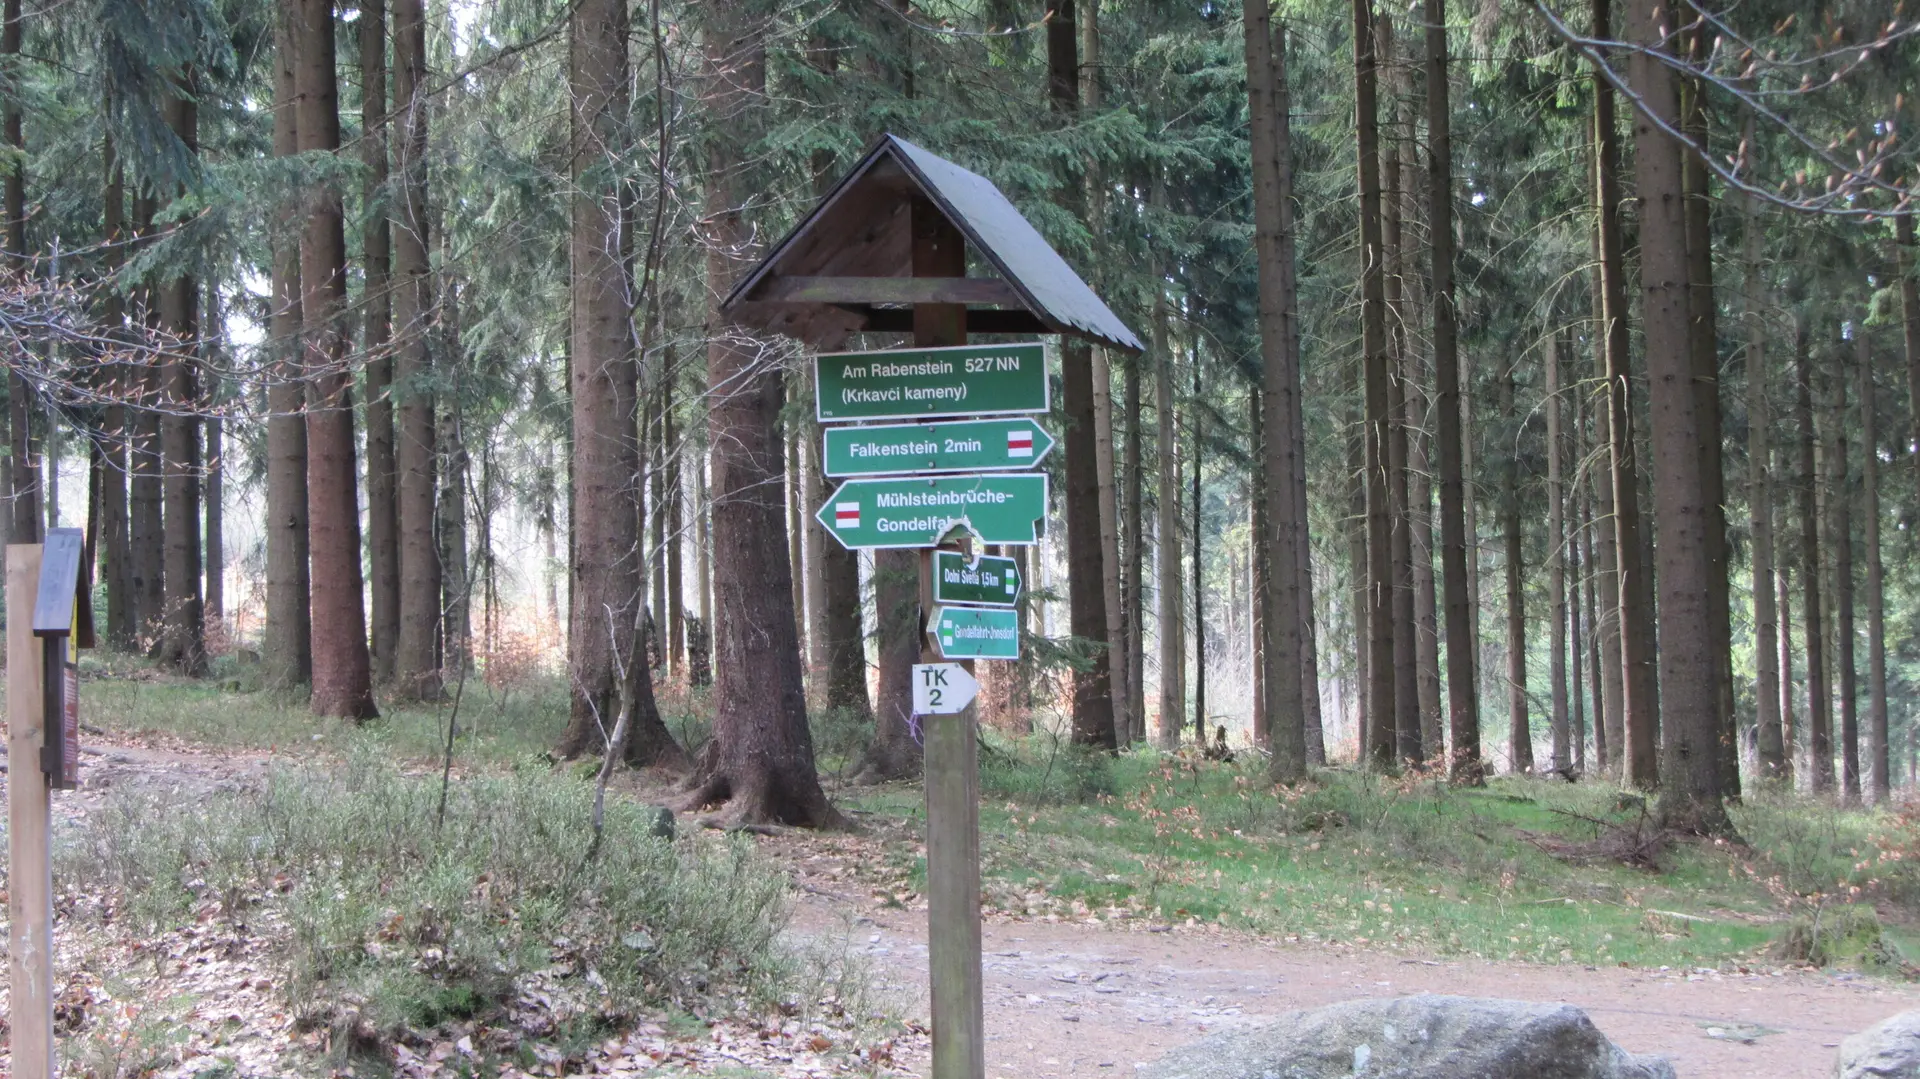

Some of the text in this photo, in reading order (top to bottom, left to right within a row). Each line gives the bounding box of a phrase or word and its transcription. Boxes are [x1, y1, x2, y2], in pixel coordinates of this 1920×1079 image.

[842, 356, 1020, 379] Am Rabenstein 527 NN
[904, 382, 967, 401] kameny)
[850, 438, 982, 457] Falkenstein 2min
[876, 489, 1014, 507] Mühlsteinbrüche-
[921, 669, 948, 686] TK
[929, 689, 943, 706] 2
